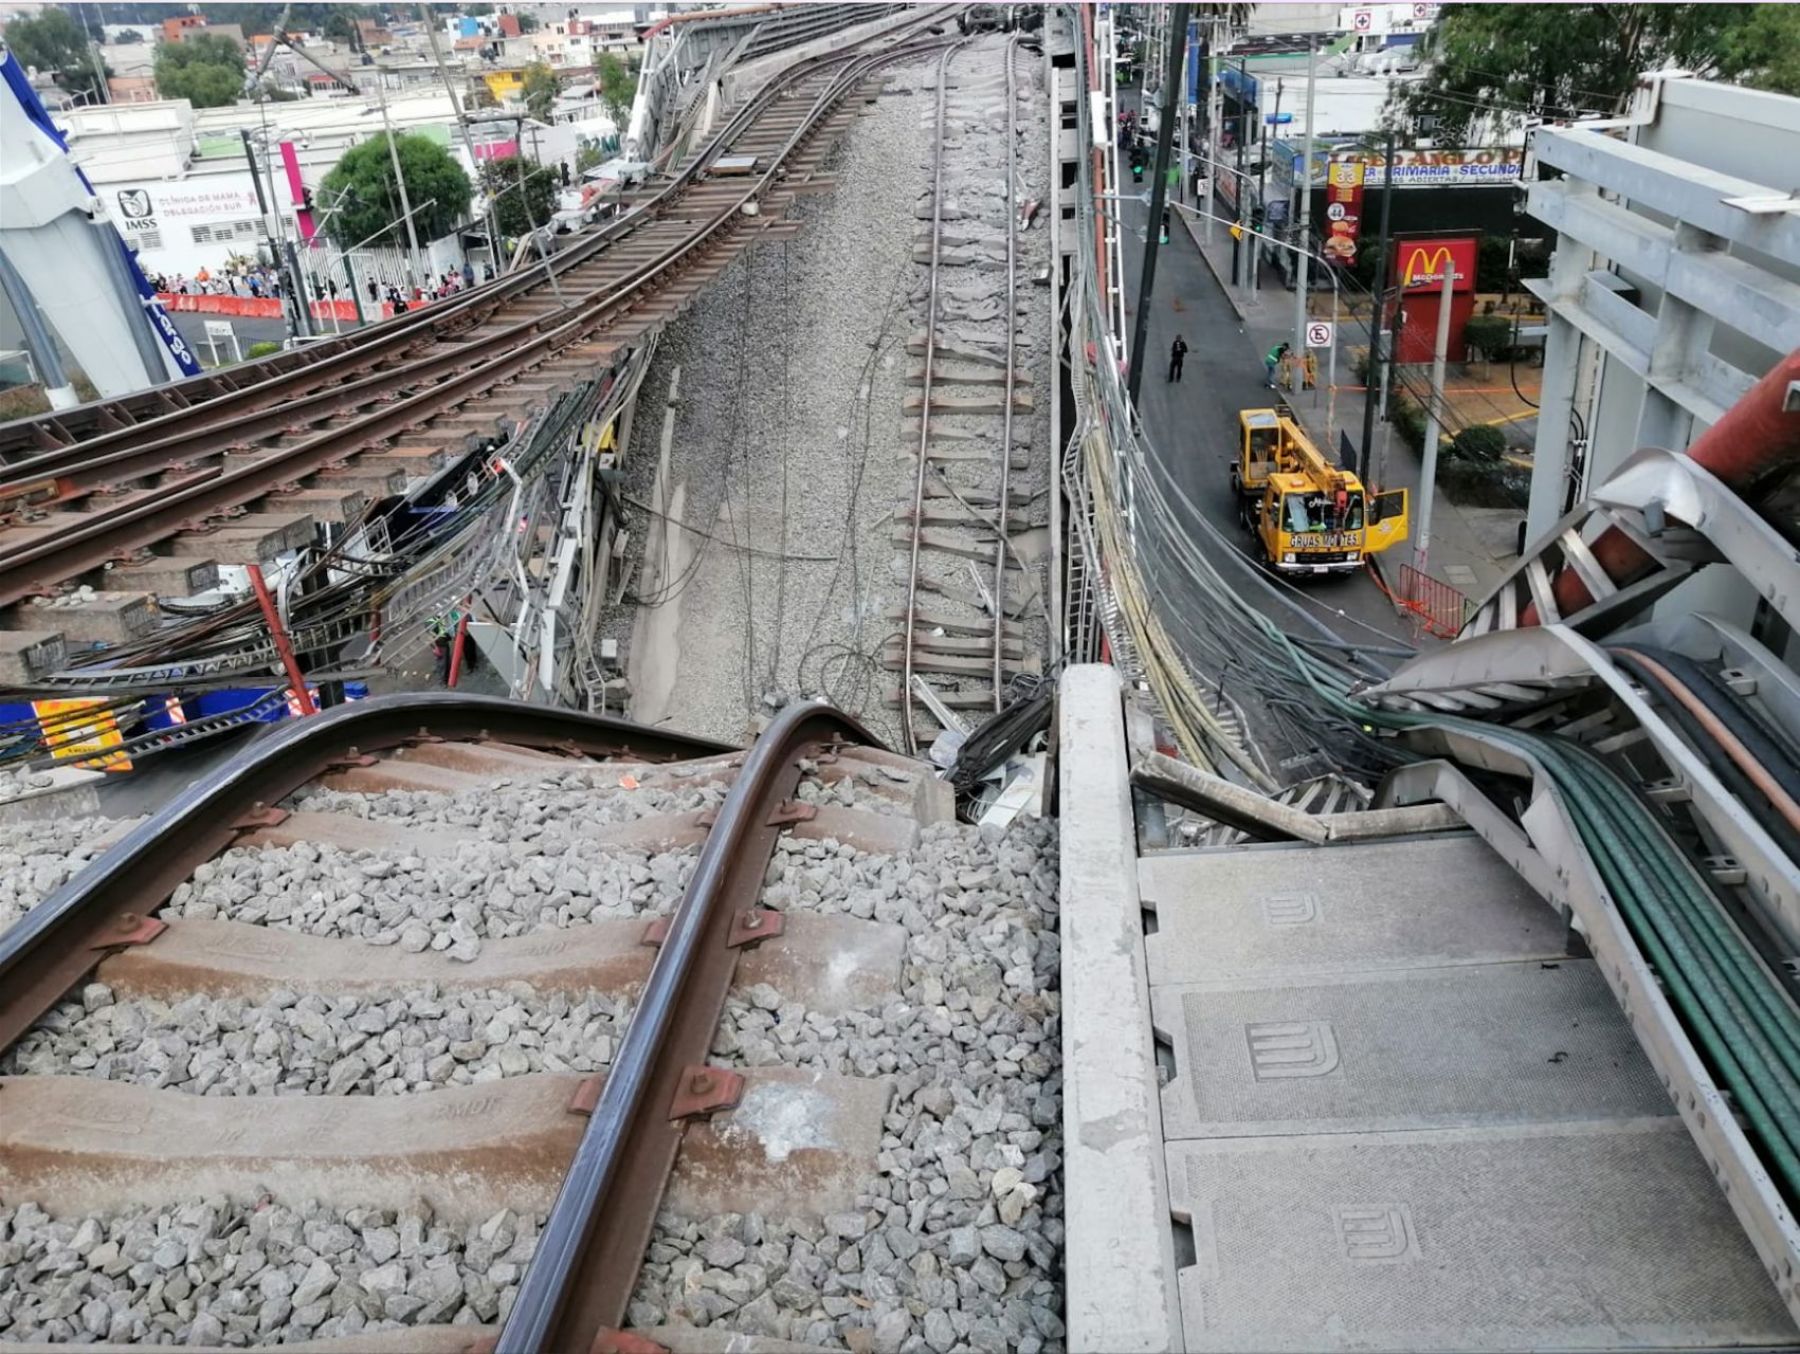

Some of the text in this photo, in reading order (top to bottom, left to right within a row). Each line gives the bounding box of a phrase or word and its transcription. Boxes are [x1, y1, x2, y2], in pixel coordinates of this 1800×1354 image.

[1391, 166, 1450, 177] RIMARIA
[125, 217, 158, 231] IMSS
[1413, 272, 1465, 282] McDond's
[151, 303, 192, 366] Largo
[1291, 535, 1320, 548] GRUAS
